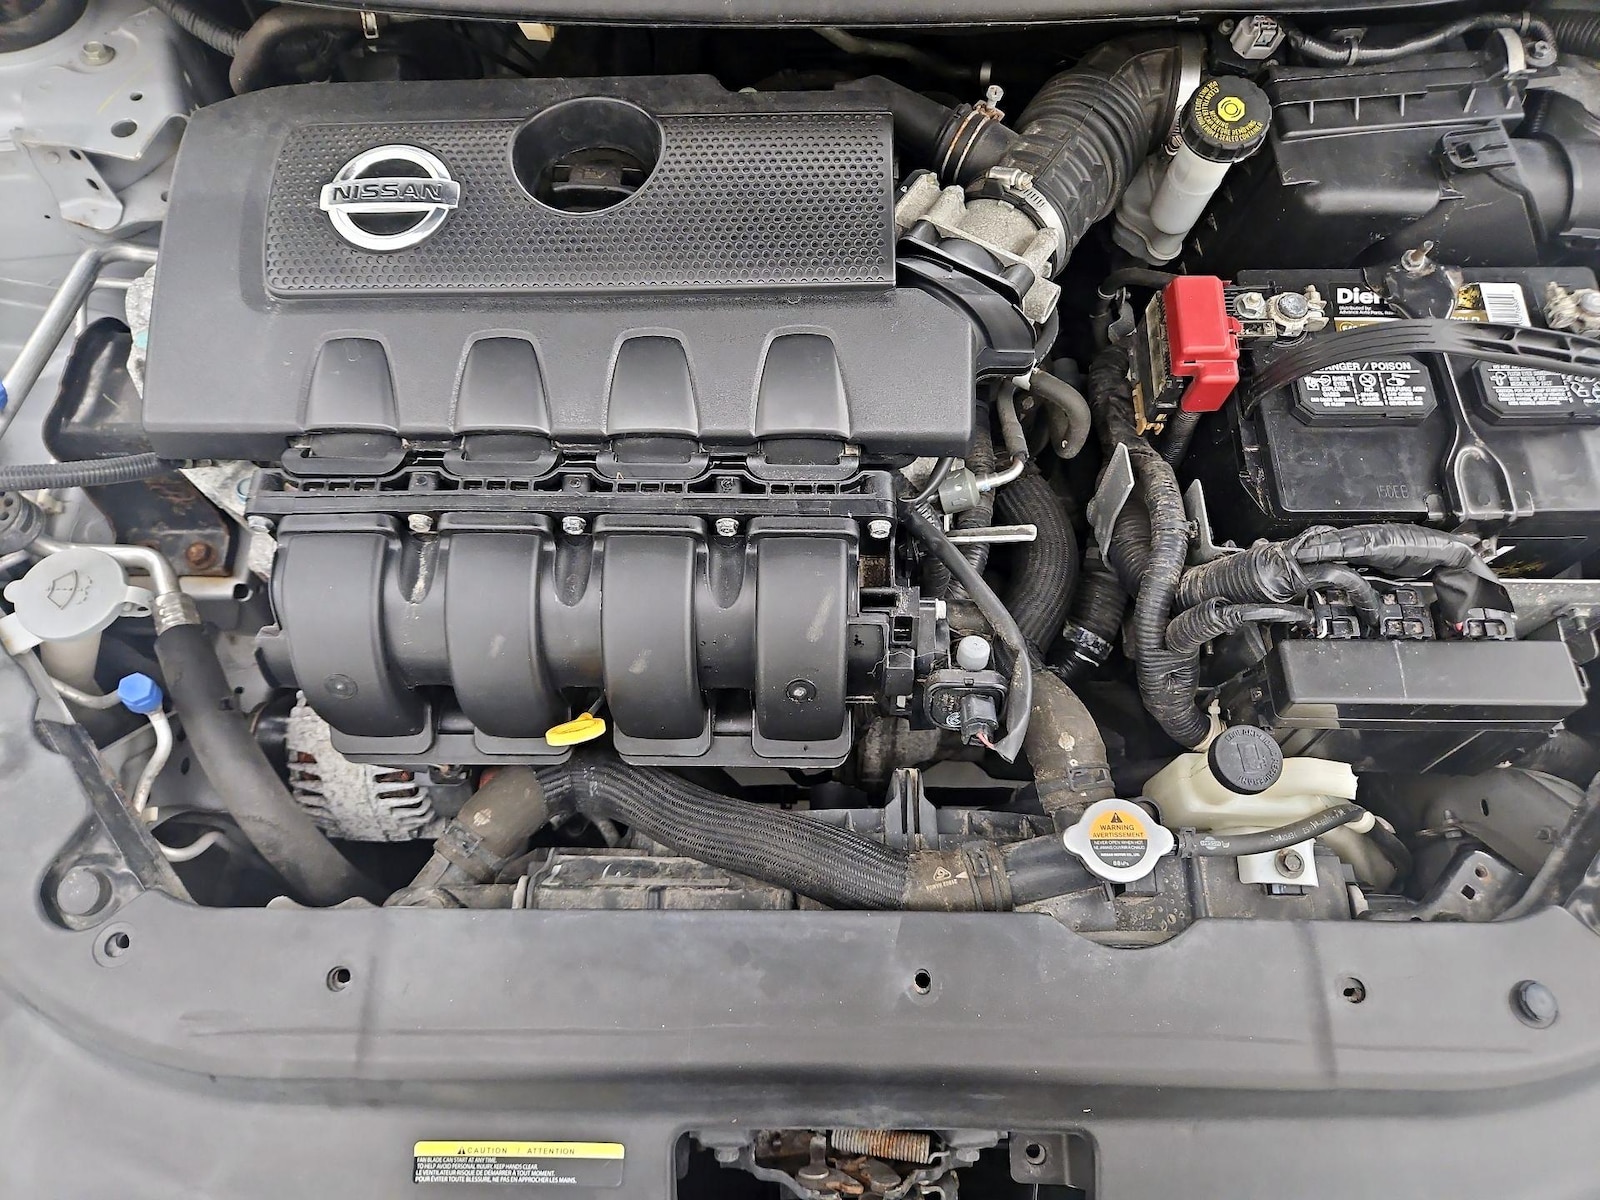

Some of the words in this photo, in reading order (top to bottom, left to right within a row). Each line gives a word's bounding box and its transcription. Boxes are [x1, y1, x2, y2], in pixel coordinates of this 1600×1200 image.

[332, 183, 442, 200] NISSAN
[1320, 362, 1360, 370] ANGER
[1371, 362, 1412, 370] POISON
